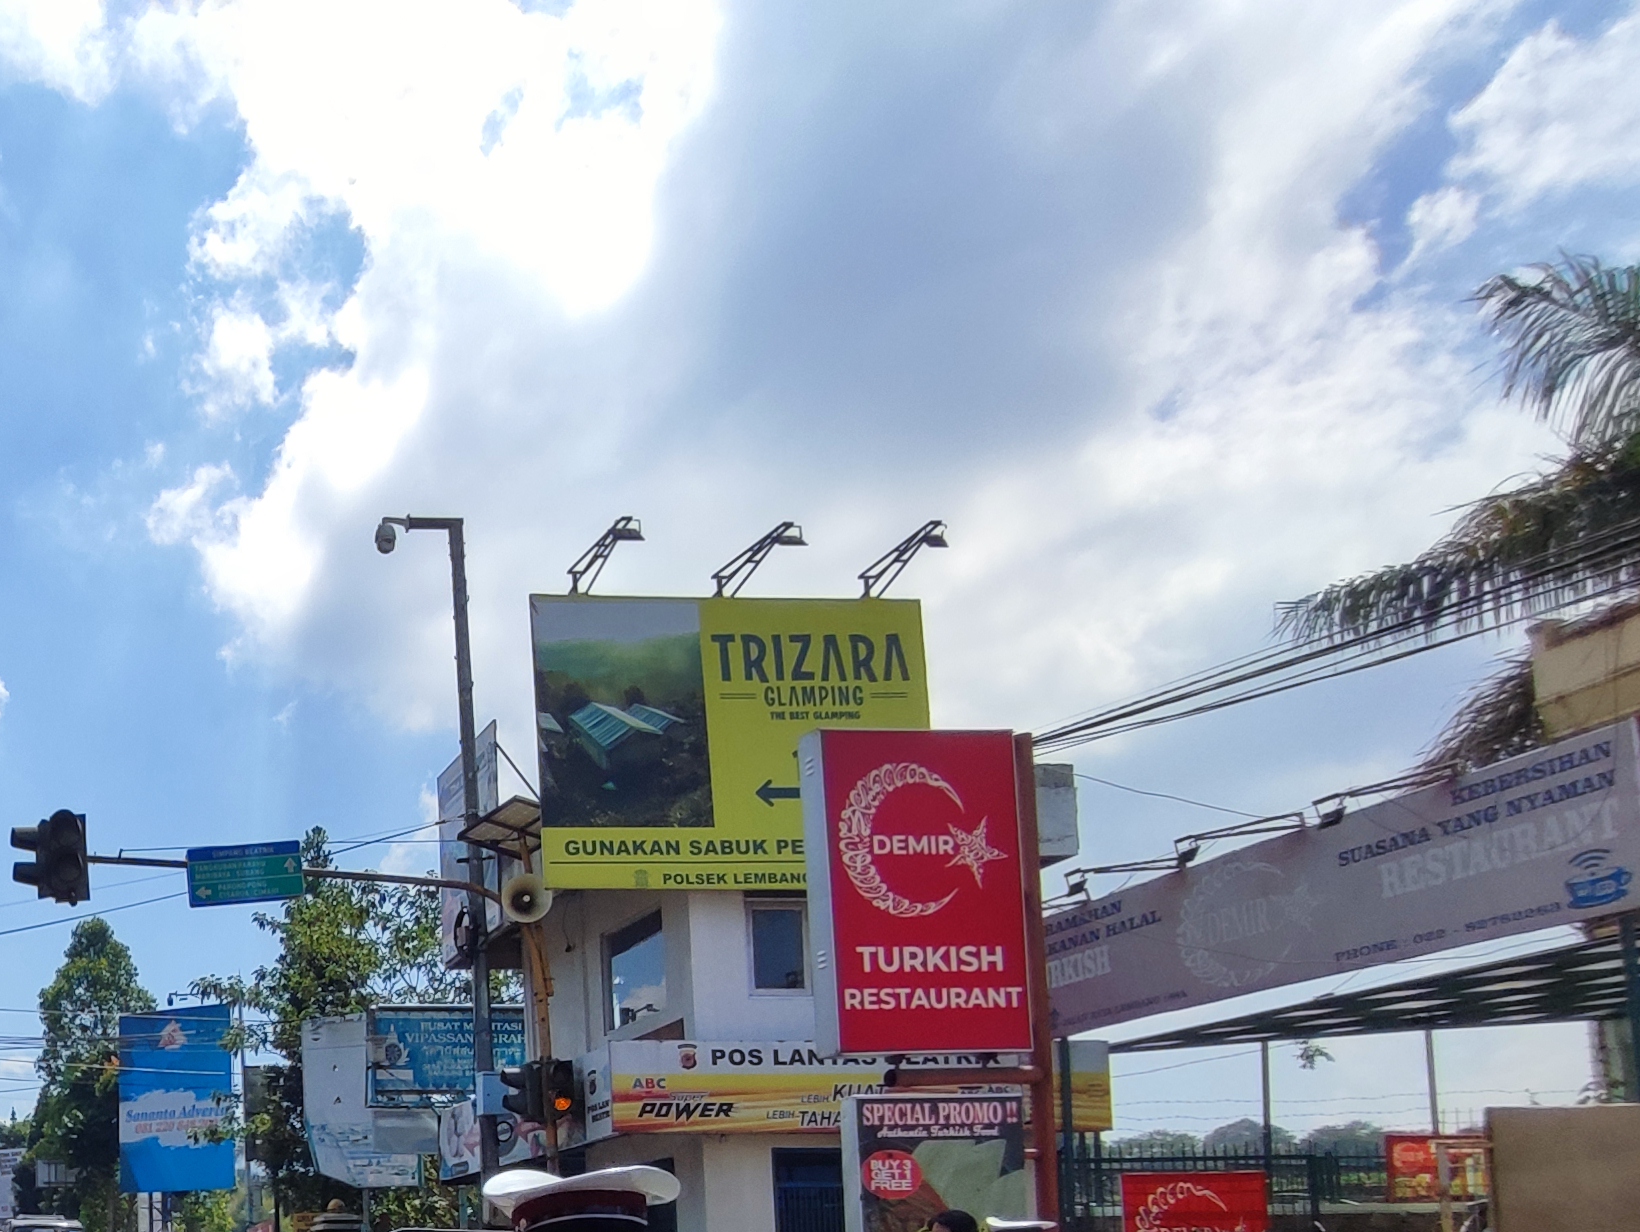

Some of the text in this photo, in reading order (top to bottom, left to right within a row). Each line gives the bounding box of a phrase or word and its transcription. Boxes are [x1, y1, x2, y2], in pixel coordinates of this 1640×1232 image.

[710, 633, 910, 683] TRIZARA
[764, 685, 864, 707] GLAMPING
[770, 711, 861, 720] THE BEST GLAMPING
[1450, 741, 1612, 806] KEBERSIHAN
[1339, 769, 1617, 867] SUASANA YANG NYAMAN
[564, 839, 680, 856] GUNAKAN
[689, 839, 769, 856] SABUK
[873, 835, 954, 855] DEMIR
[1379, 799, 1619, 899] RESTAURANT
[662, 873, 727, 885] POLSEK
[1106, 910, 1162, 938] HALAL
[855, 945, 1004, 973] TURKISH
[1335, 939, 1396, 962] PHONE
[844, 987, 1022, 1010] RESTAURANT
[463, 1022, 522, 1031] MITASI
[404, 1033, 475, 1044] VIPASSAN
[712, 1049, 764, 1066] POS
[632, 1077, 666, 1089] ABC
[670, 1092, 709, 1102] Super
[801, 1095, 830, 1104] LEBIH
[126, 1108, 176, 1122] Sananta
[638, 1102, 734, 1124] POWER
[766, 1110, 796, 1120] LEBIH
[863, 1101, 1018, 1126] SPECIAL PROMO !!
[877, 1124, 999, 1138] Authentic Turkish Food
[870, 1160, 911, 1170] BUY 3
[871, 1170, 911, 1180] GET 1
[871, 1180, 912, 1191] FREE
